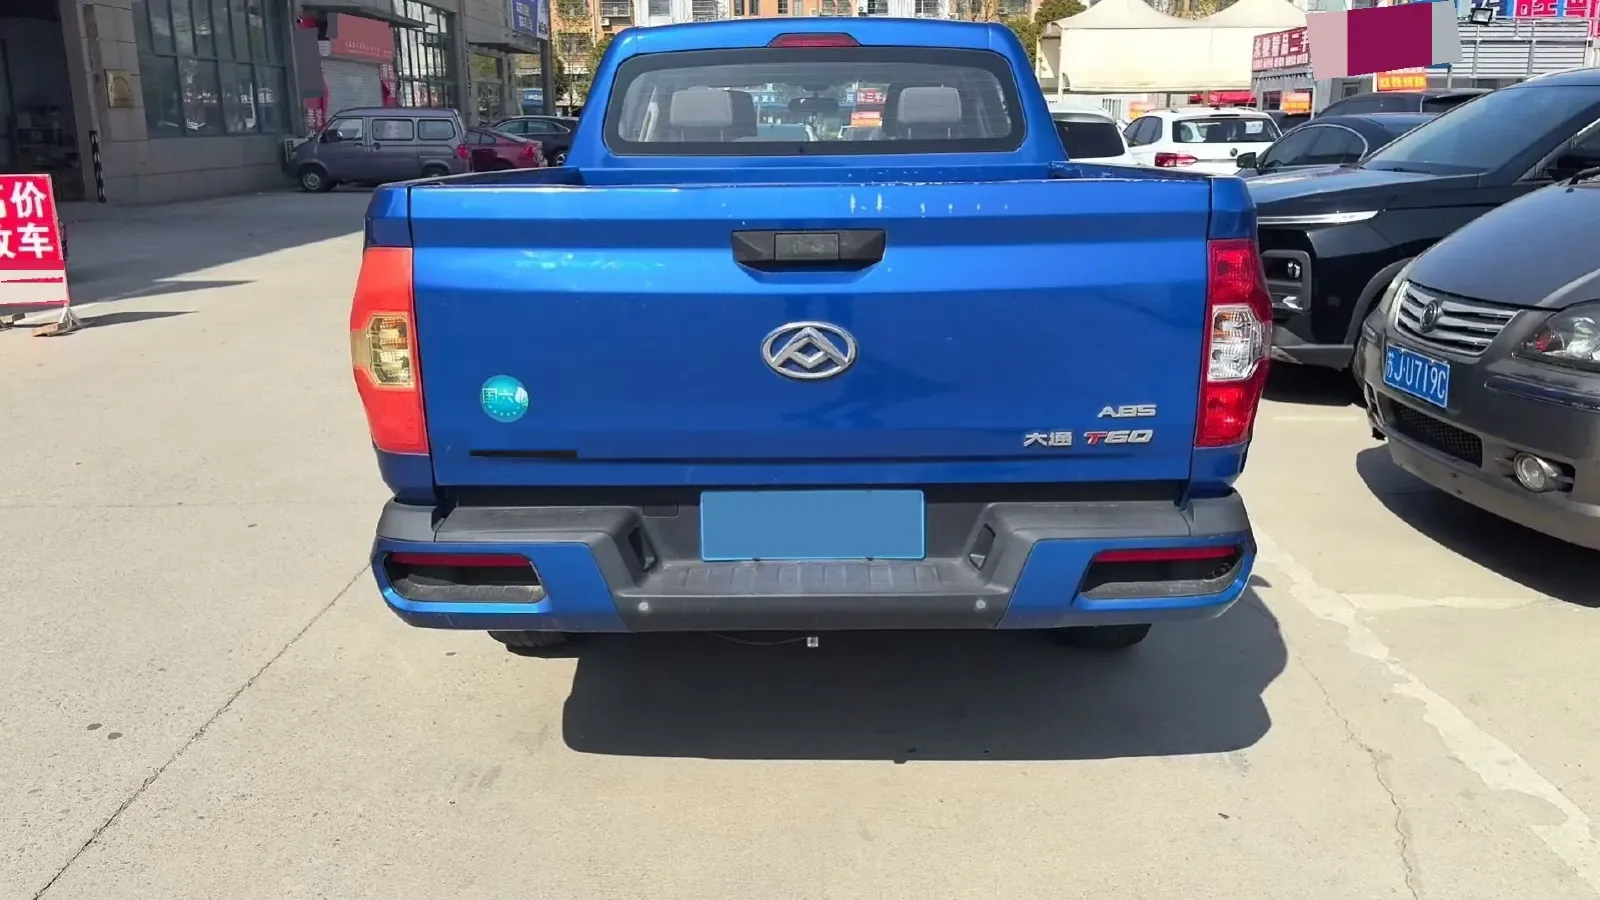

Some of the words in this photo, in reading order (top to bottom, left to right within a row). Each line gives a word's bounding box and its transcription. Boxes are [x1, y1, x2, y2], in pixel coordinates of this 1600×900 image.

[0, 181, 47, 219] 价
[482, 387, 514, 404] 国六
[1097, 404, 1157, 418] ABS
[1023, 432, 1073, 447] 大通
[1083, 429, 1153, 445] T60
